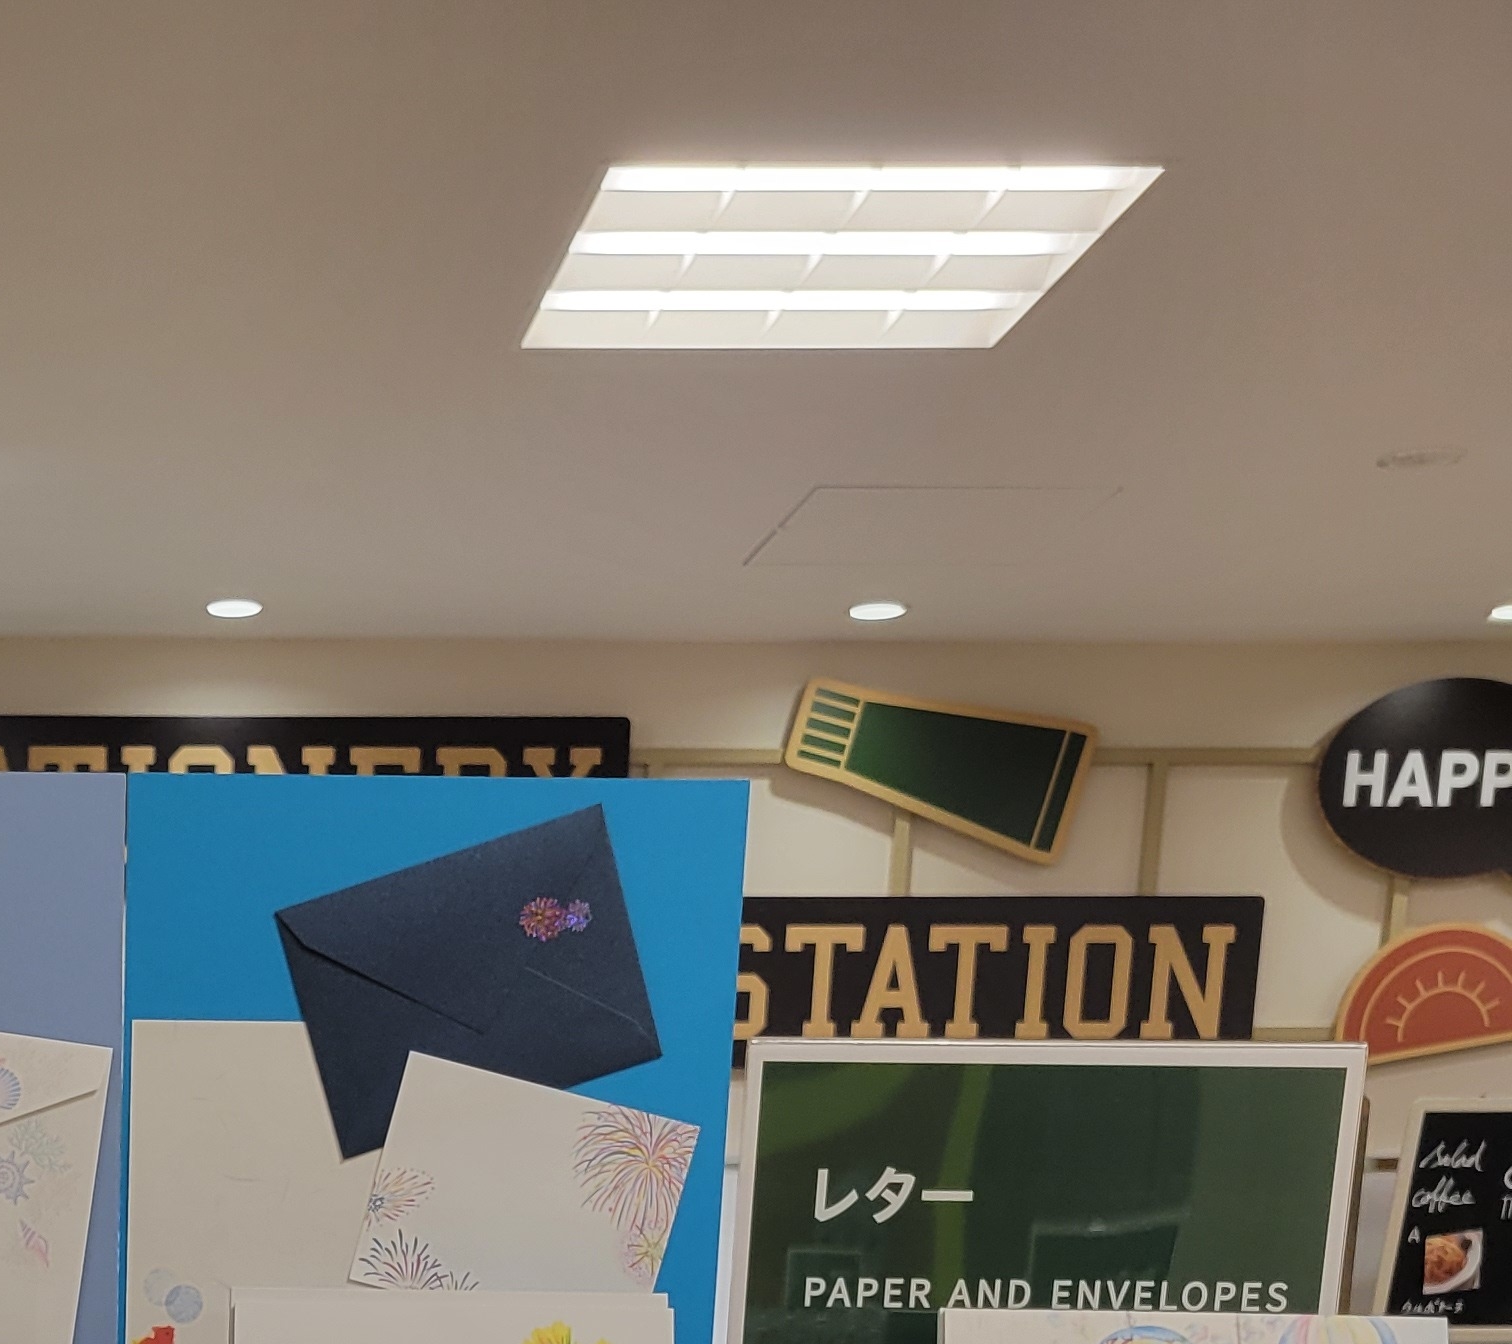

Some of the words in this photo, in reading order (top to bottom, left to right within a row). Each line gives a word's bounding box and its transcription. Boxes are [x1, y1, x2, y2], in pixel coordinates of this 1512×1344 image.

[814, 1166, 974, 1224] レター
[803, 1277, 931, 1308] PAPER
[950, 1279, 1032, 1310] AND
[1051, 1281, 1288, 1313] ENVELOPES
